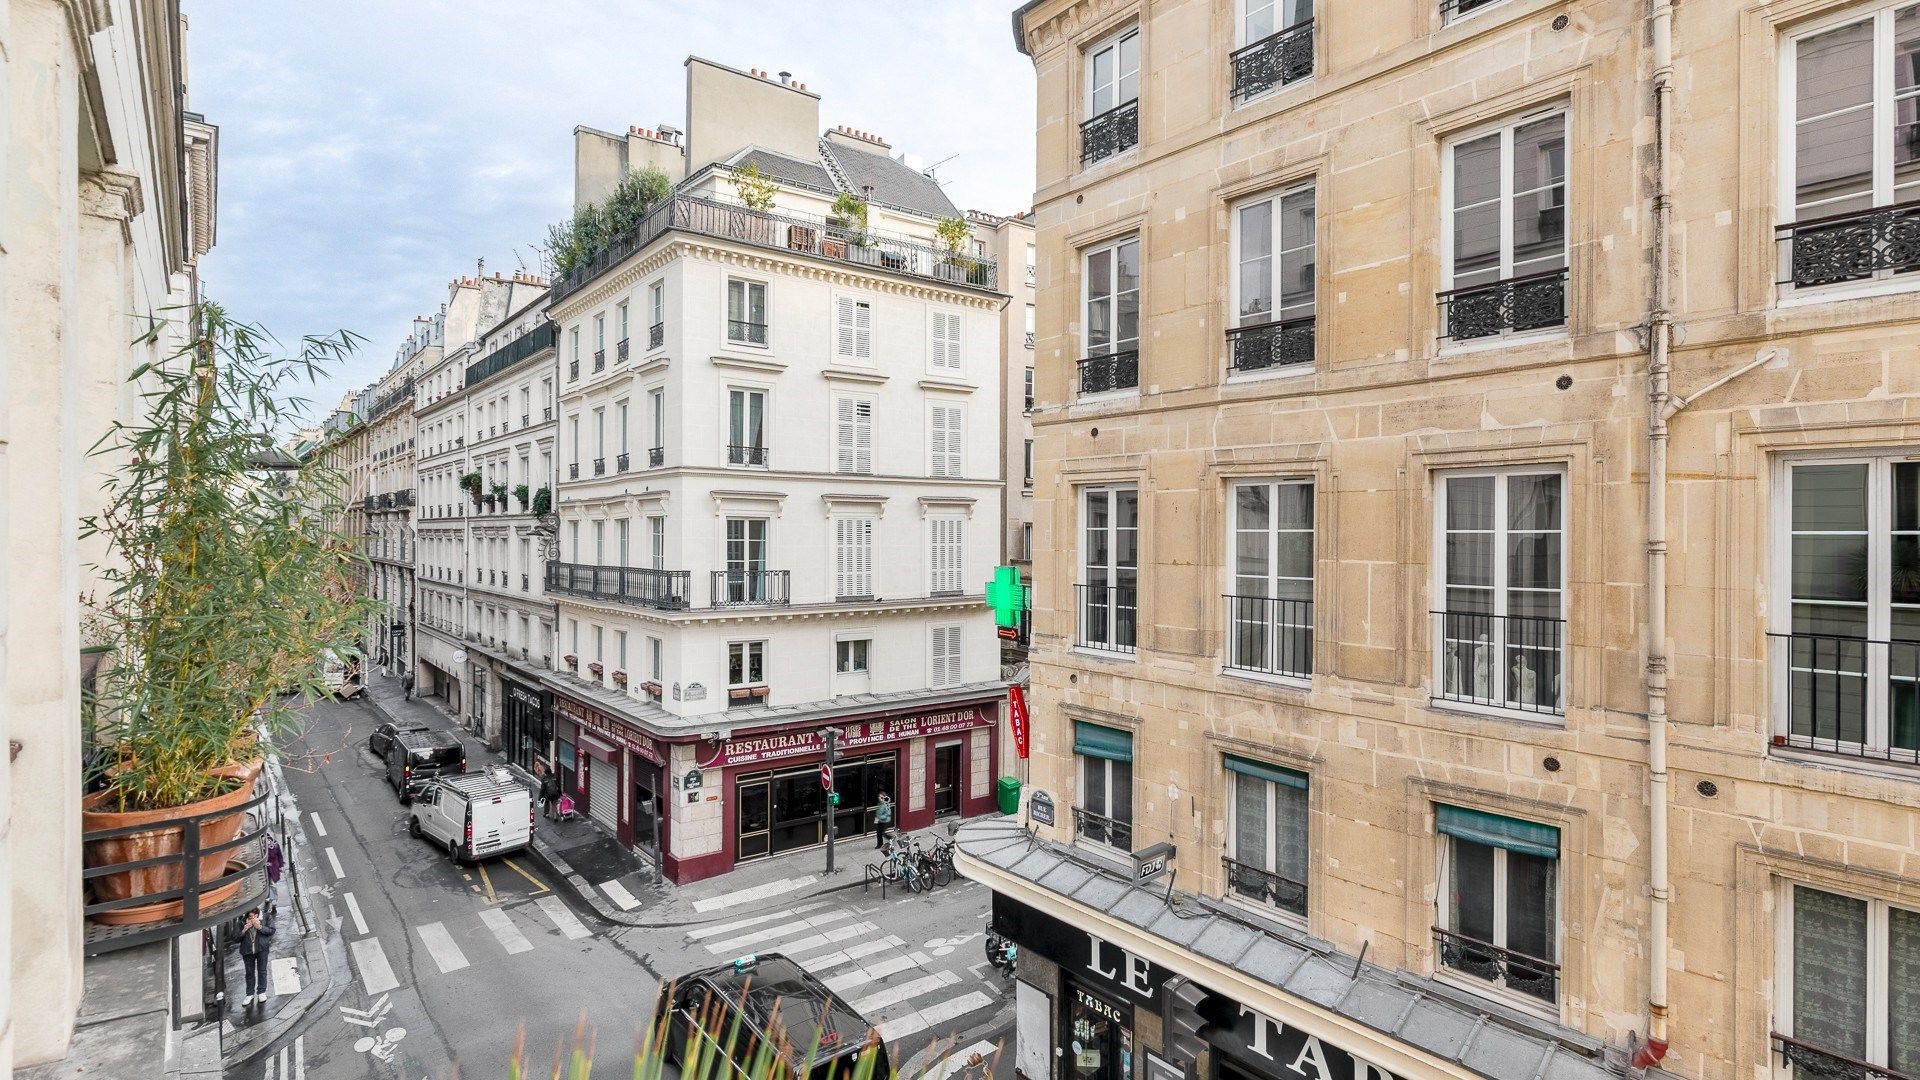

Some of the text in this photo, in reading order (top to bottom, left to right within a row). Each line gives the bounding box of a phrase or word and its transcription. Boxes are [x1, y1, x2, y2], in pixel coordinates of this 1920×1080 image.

[889, 717, 917, 727] SALON
[1012, 700, 1023, 744] TABAC
[724, 732, 815, 756] RESTAURANT
[727, 753, 757, 764] CUISINE
[761, 744, 821, 759] TRADITIONNELLE
[849, 734, 884, 746] PROVINCE
[886, 732, 895, 740] DE
[898, 729, 919, 738] HUNAN
[1140, 861, 1156, 877] FDJ
[1086, 932, 1154, 998] LE
[1076, 989, 1121, 1023] TABAC
